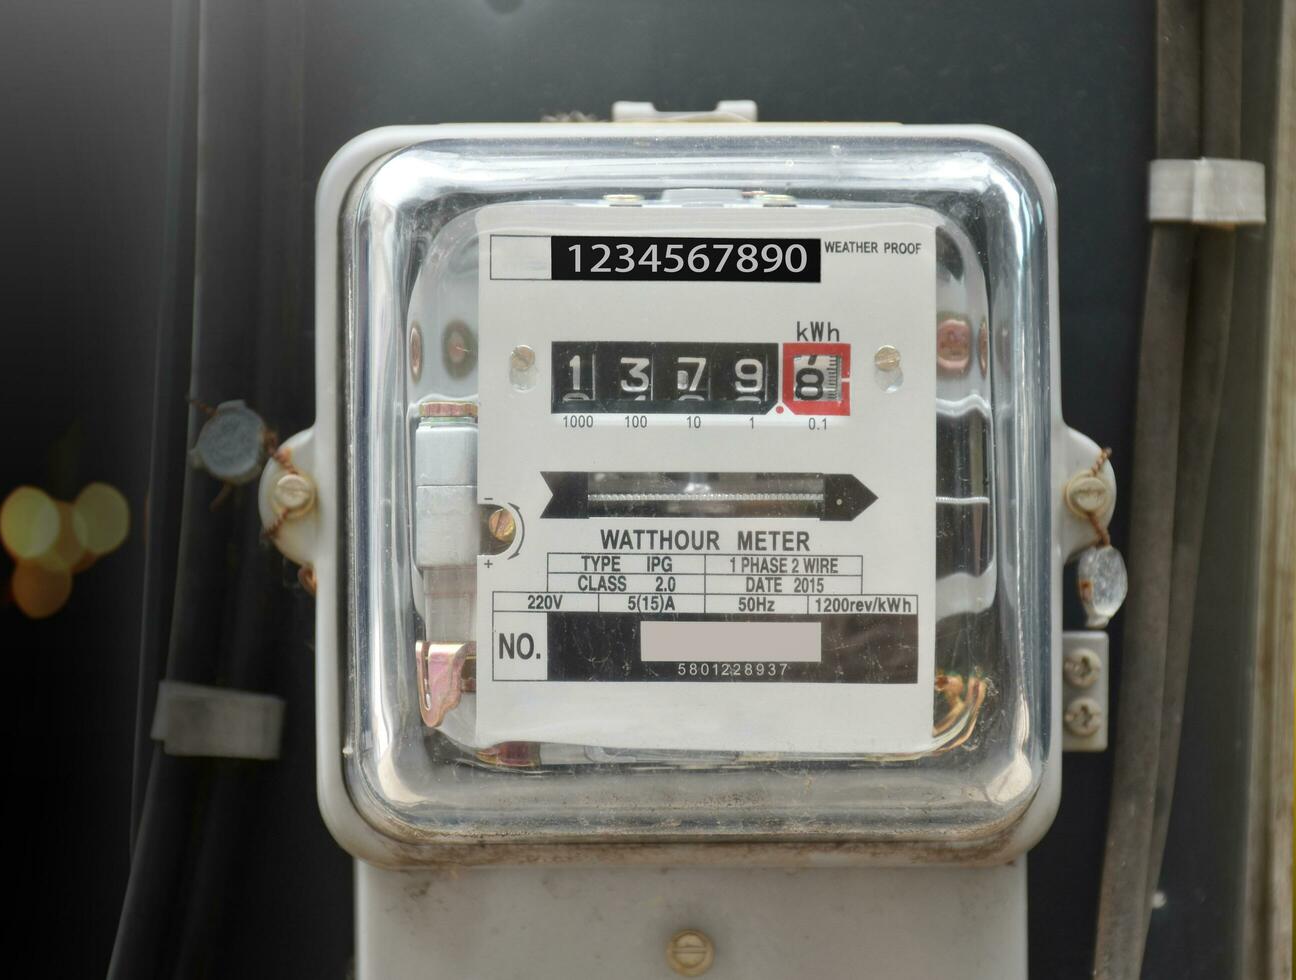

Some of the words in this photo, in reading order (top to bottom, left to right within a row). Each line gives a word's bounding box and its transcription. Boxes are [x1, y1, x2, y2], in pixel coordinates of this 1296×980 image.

[824, 240, 879, 254] WEATHER
[883, 241, 922, 255] PROOF
[567, 243, 808, 274] 1234567890
[796, 321, 840, 342] kWh
[562, 415, 594, 429] 1000
[624, 415, 648, 429] 100
[686, 415, 702, 429] 10
[748, 415, 755, 429] 1
[808, 417, 828, 431] 0.1
[600, 529, 721, 551] WATTHOUR
[737, 530, 811, 552] METER
[581, 556, 621, 573] TYPE
[647, 556, 673, 573] IPG
[729, 557, 736, 573] 1
[741, 557, 789, 574] PHASE
[791, 557, 800, 574] 2
[802, 557, 839, 574] WIRE
[577, 575, 627, 592] CLASS
[655, 576, 677, 592] 2.0
[745, 576, 783, 593] DATE
[793, 577, 825, 594] 2015
[527, 594, 563, 610] 220V
[627, 594, 676, 613] 5(15)A
[738, 595, 776, 612] 50Hz
[814, 596, 912, 613] 1200rev/kWh
[498, 632, 542, 660] NO.
[678, 663, 788, 676] 5801228937
